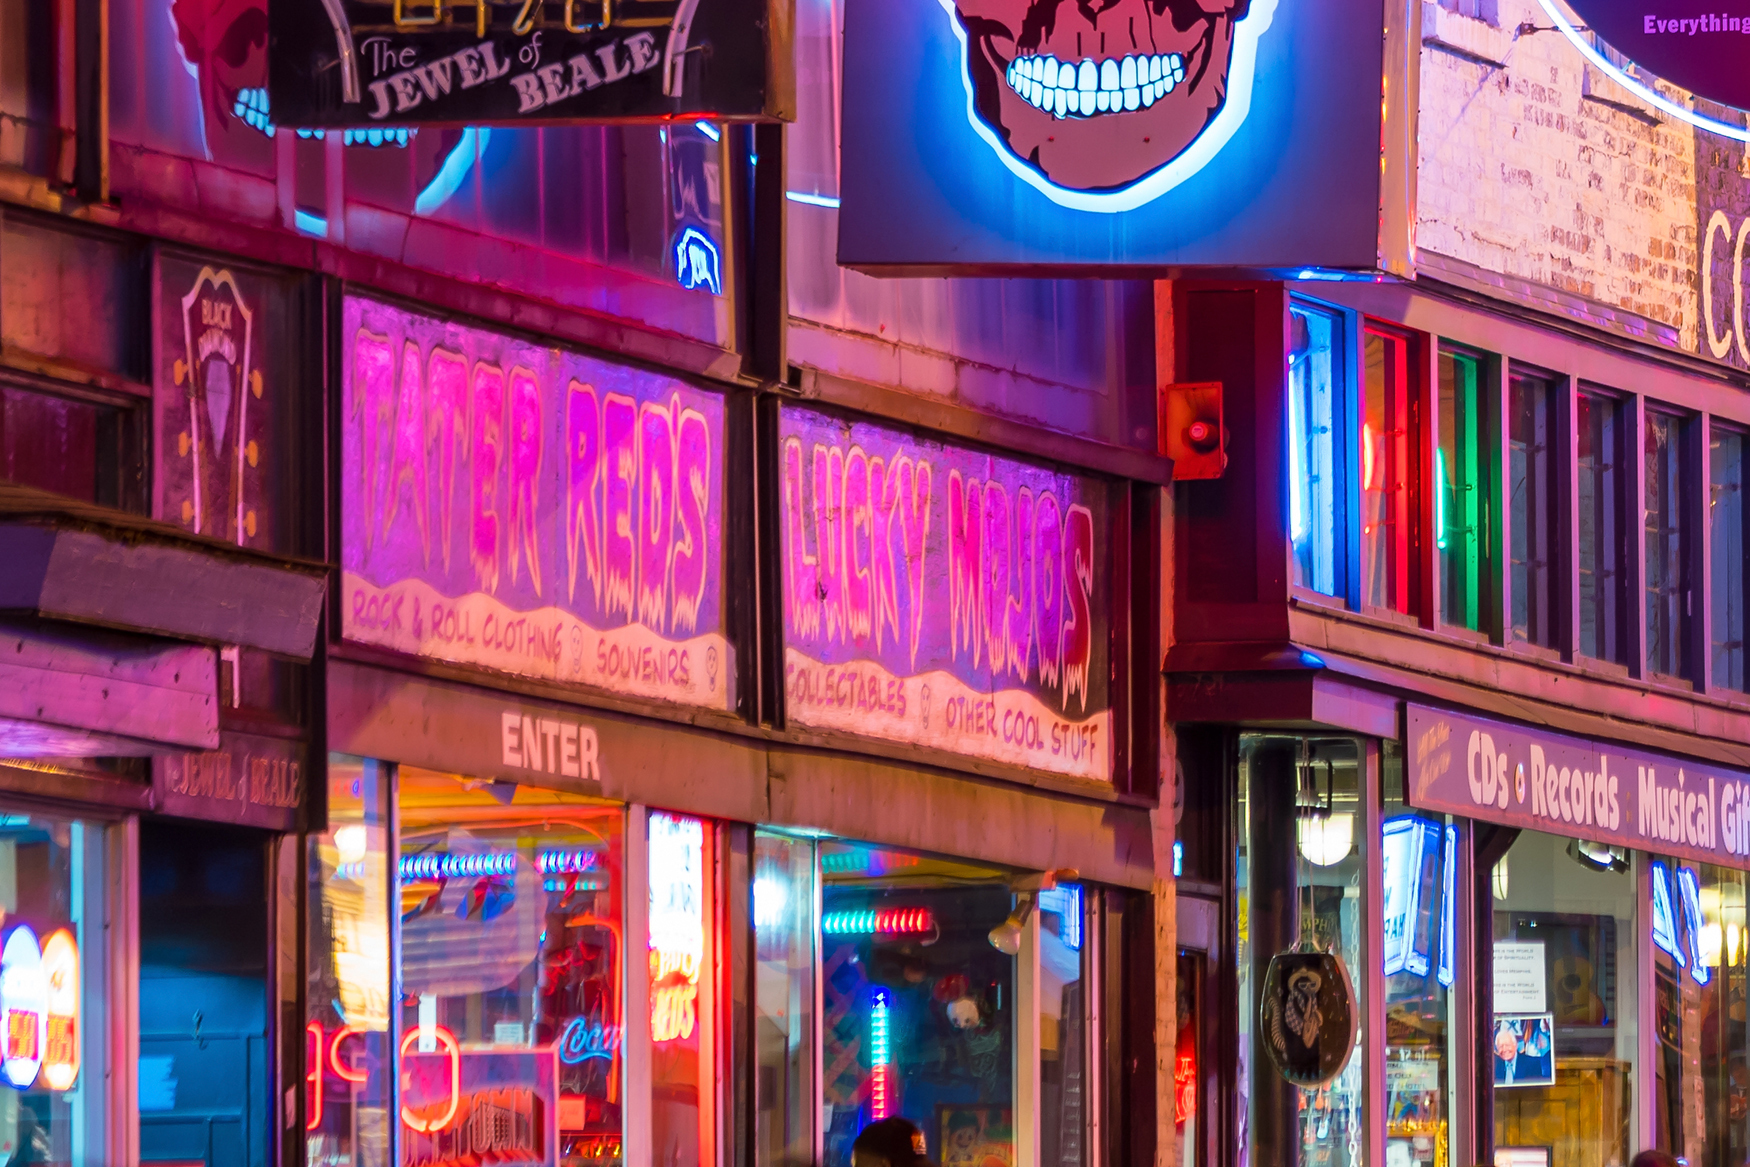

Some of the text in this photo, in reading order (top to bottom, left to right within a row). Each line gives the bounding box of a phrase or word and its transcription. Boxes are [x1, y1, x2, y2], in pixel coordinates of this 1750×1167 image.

[361, 31, 661, 120] The JEWEL of BEALE
[352, 327, 543, 598] TATER
[565, 377, 711, 636] RED'S
[785, 436, 932, 671] LUCKY
[353, 589, 691, 687] ROCK & ROLL CLOTHING SOUVENIRS
[502, 712, 600, 781] ENTER
[786, 663, 1099, 764] COLLECTABLES OTHER COOL STUFF
[180, 751, 236, 801] JEWEL
[250, 756, 300, 809] BEALE
[1468, 730, 1508, 810] CDs
[1531, 744, 1620, 832] Records
[1637, 766, 1716, 851] Musical
